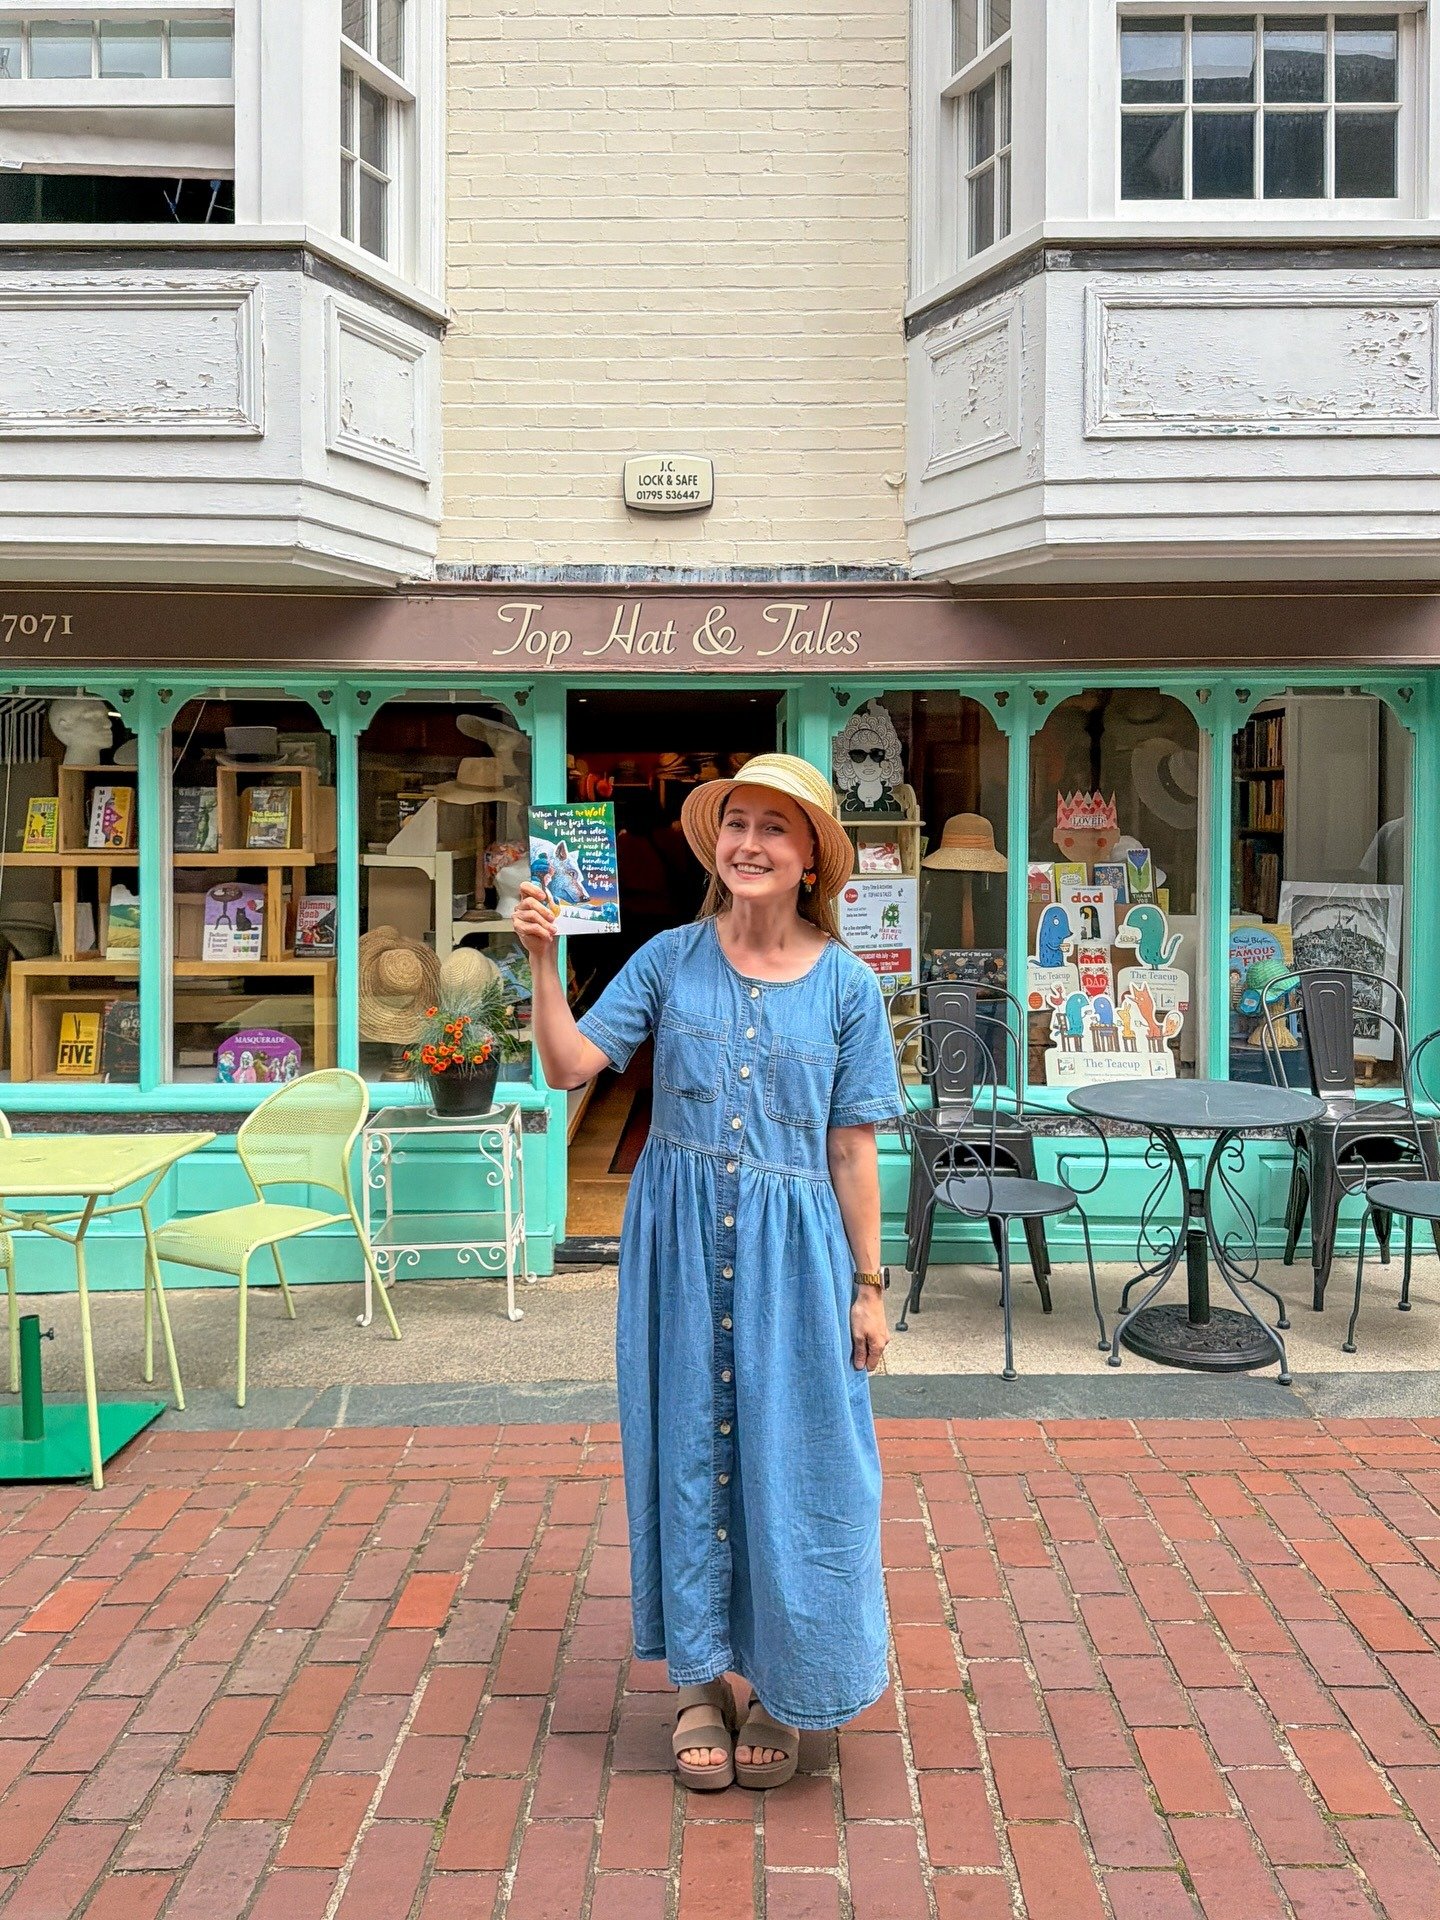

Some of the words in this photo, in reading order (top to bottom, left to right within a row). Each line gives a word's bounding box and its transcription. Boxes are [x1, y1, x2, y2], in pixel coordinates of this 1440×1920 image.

[660, 461, 676, 472] J.C.
[638, 475, 664, 486] LOCK
[666, 475, 673, 486] &
[675, 474, 698, 486] SAFE
[636, 490, 663, 500] 01795
[665, 490, 701, 500] 536447
[1, 613, 74, 643] 7071
[492, 602, 573, 665] Top
[582, 602, 679, 657] Hat
[692, 604, 744, 657] &
[756, 600, 863, 657] Tales
[531, 811, 553, 819] When
[554, 809, 558, 818] I
[559, 809, 574, 817] met
[584, 803, 607, 818] Wolf
[543, 819, 553, 830] for
[556, 819, 568, 827] the
[568, 819, 584, 829] first
[554, 828, 558, 837] I
[560, 827, 576, 836] had
[589, 827, 606, 835] idea
[582, 857, 610, 865] hundred
[581, 864, 615, 874] kilometres
[1071, 892, 1104, 904] dad
[300, 900, 331, 910] Wimmy
[1229, 946, 1276, 959] FAMOUS
[1242, 954, 1273, 967] FIVE
[1033, 972, 1047, 980] The
[1048, 971, 1071, 982] Teacup
[1130, 971, 1146, 980] The
[1149, 970, 1178, 982] Teacup
[1086, 977, 1106, 988] DAD
[235, 1036, 287, 1044] MASQUERADE
[60, 1044, 94, 1064] FIVE
[1083, 1058, 1103, 1068] The
[1105, 1058, 1141, 1071] Teacup
